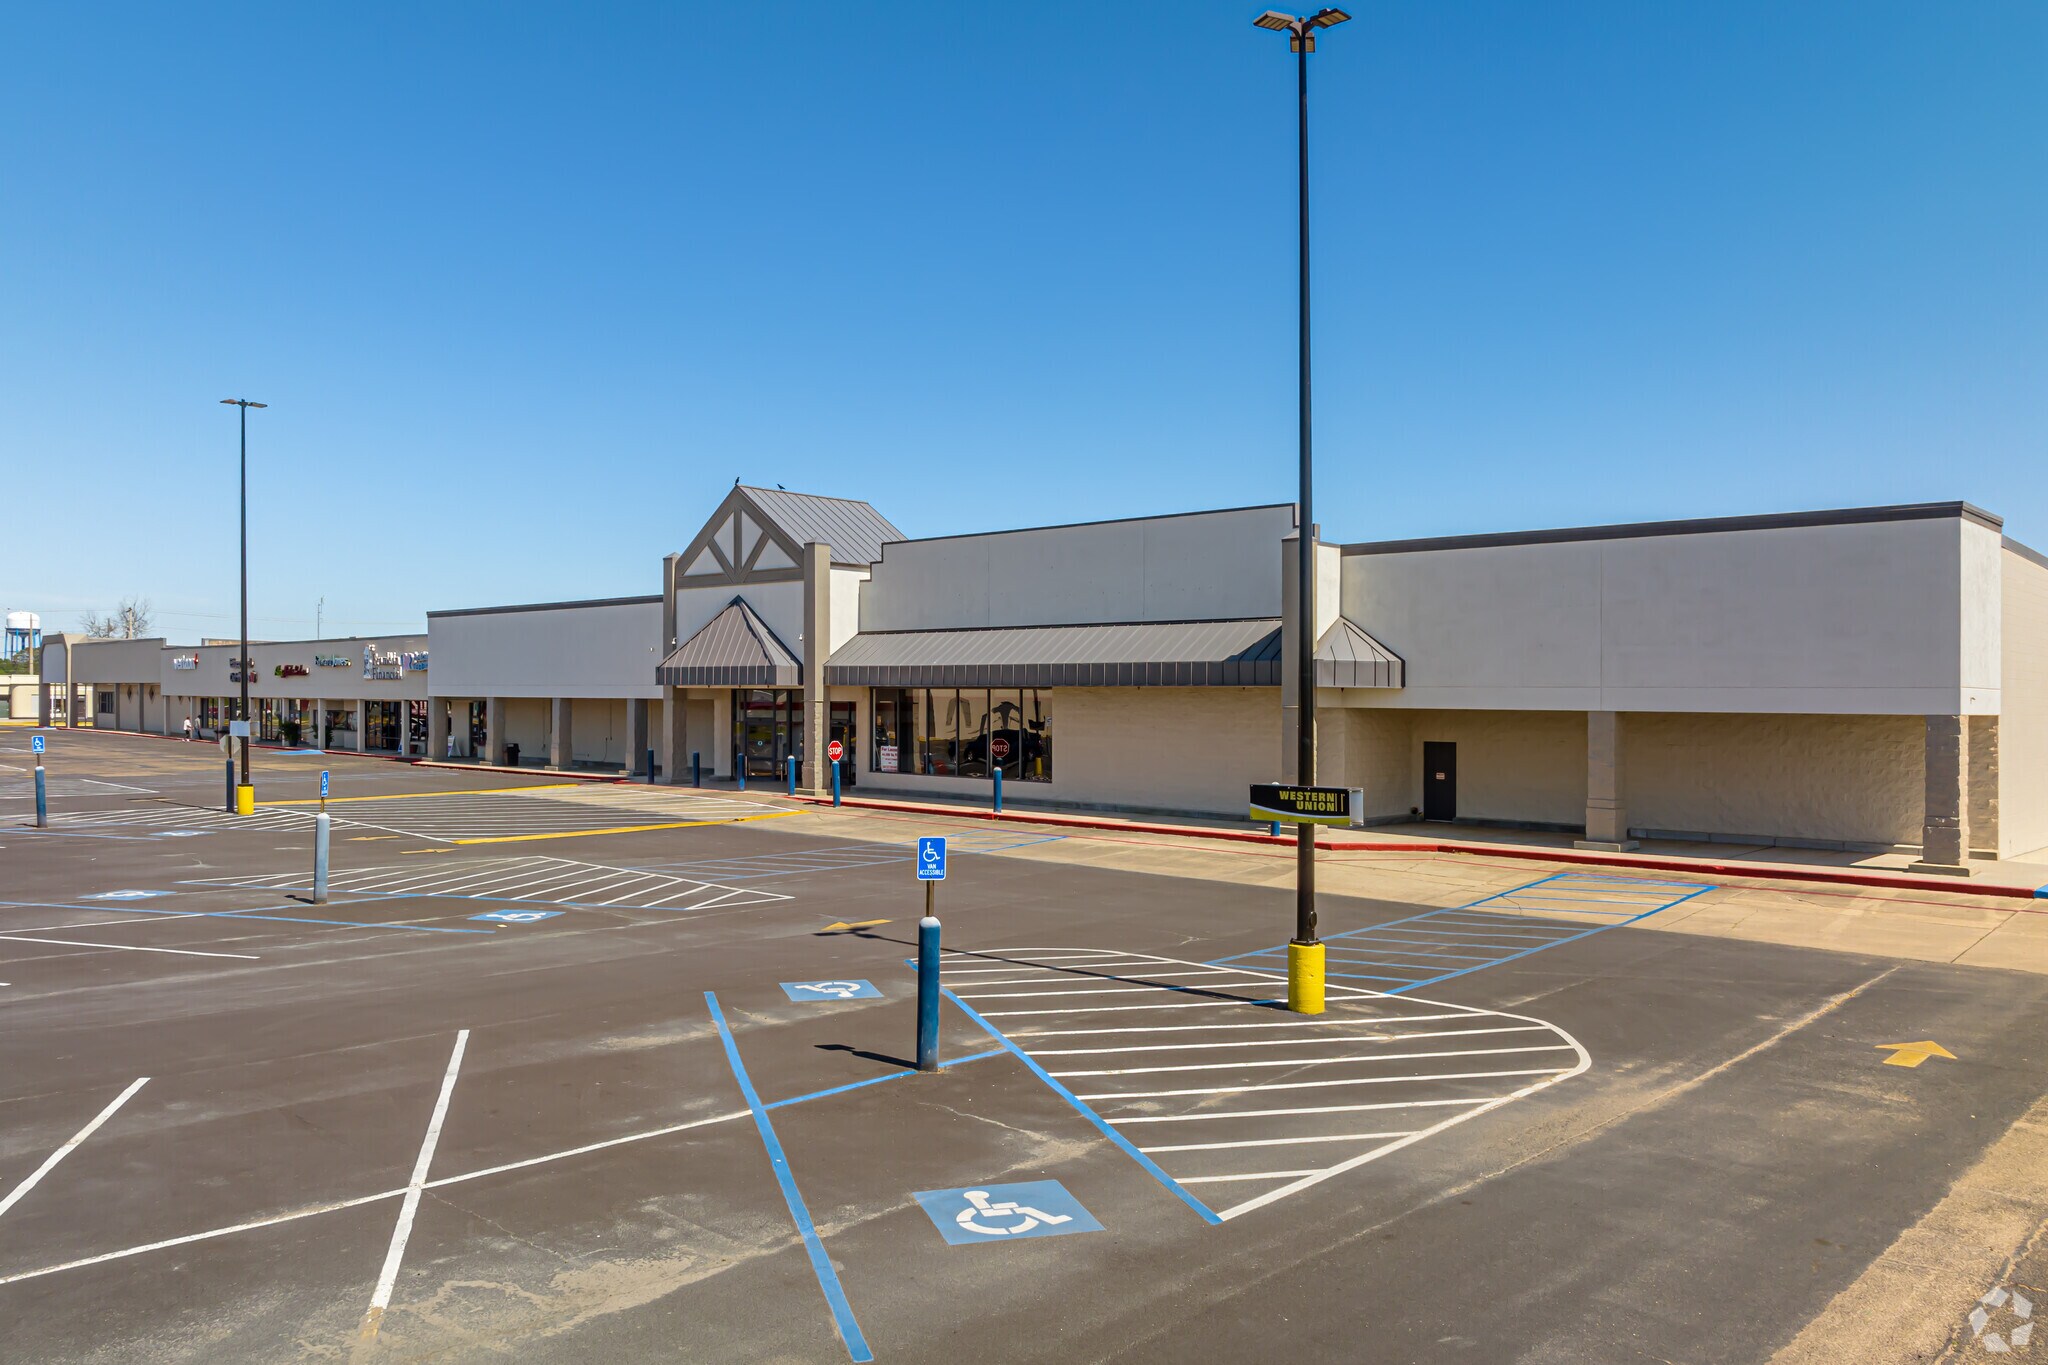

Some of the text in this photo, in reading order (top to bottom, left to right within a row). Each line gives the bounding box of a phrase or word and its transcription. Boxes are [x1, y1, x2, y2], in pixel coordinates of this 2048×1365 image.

[829, 747, 842, 755] STOP
[1279, 791, 1334, 802] WESTERN
[1296, 801, 1334, 811] UNION
